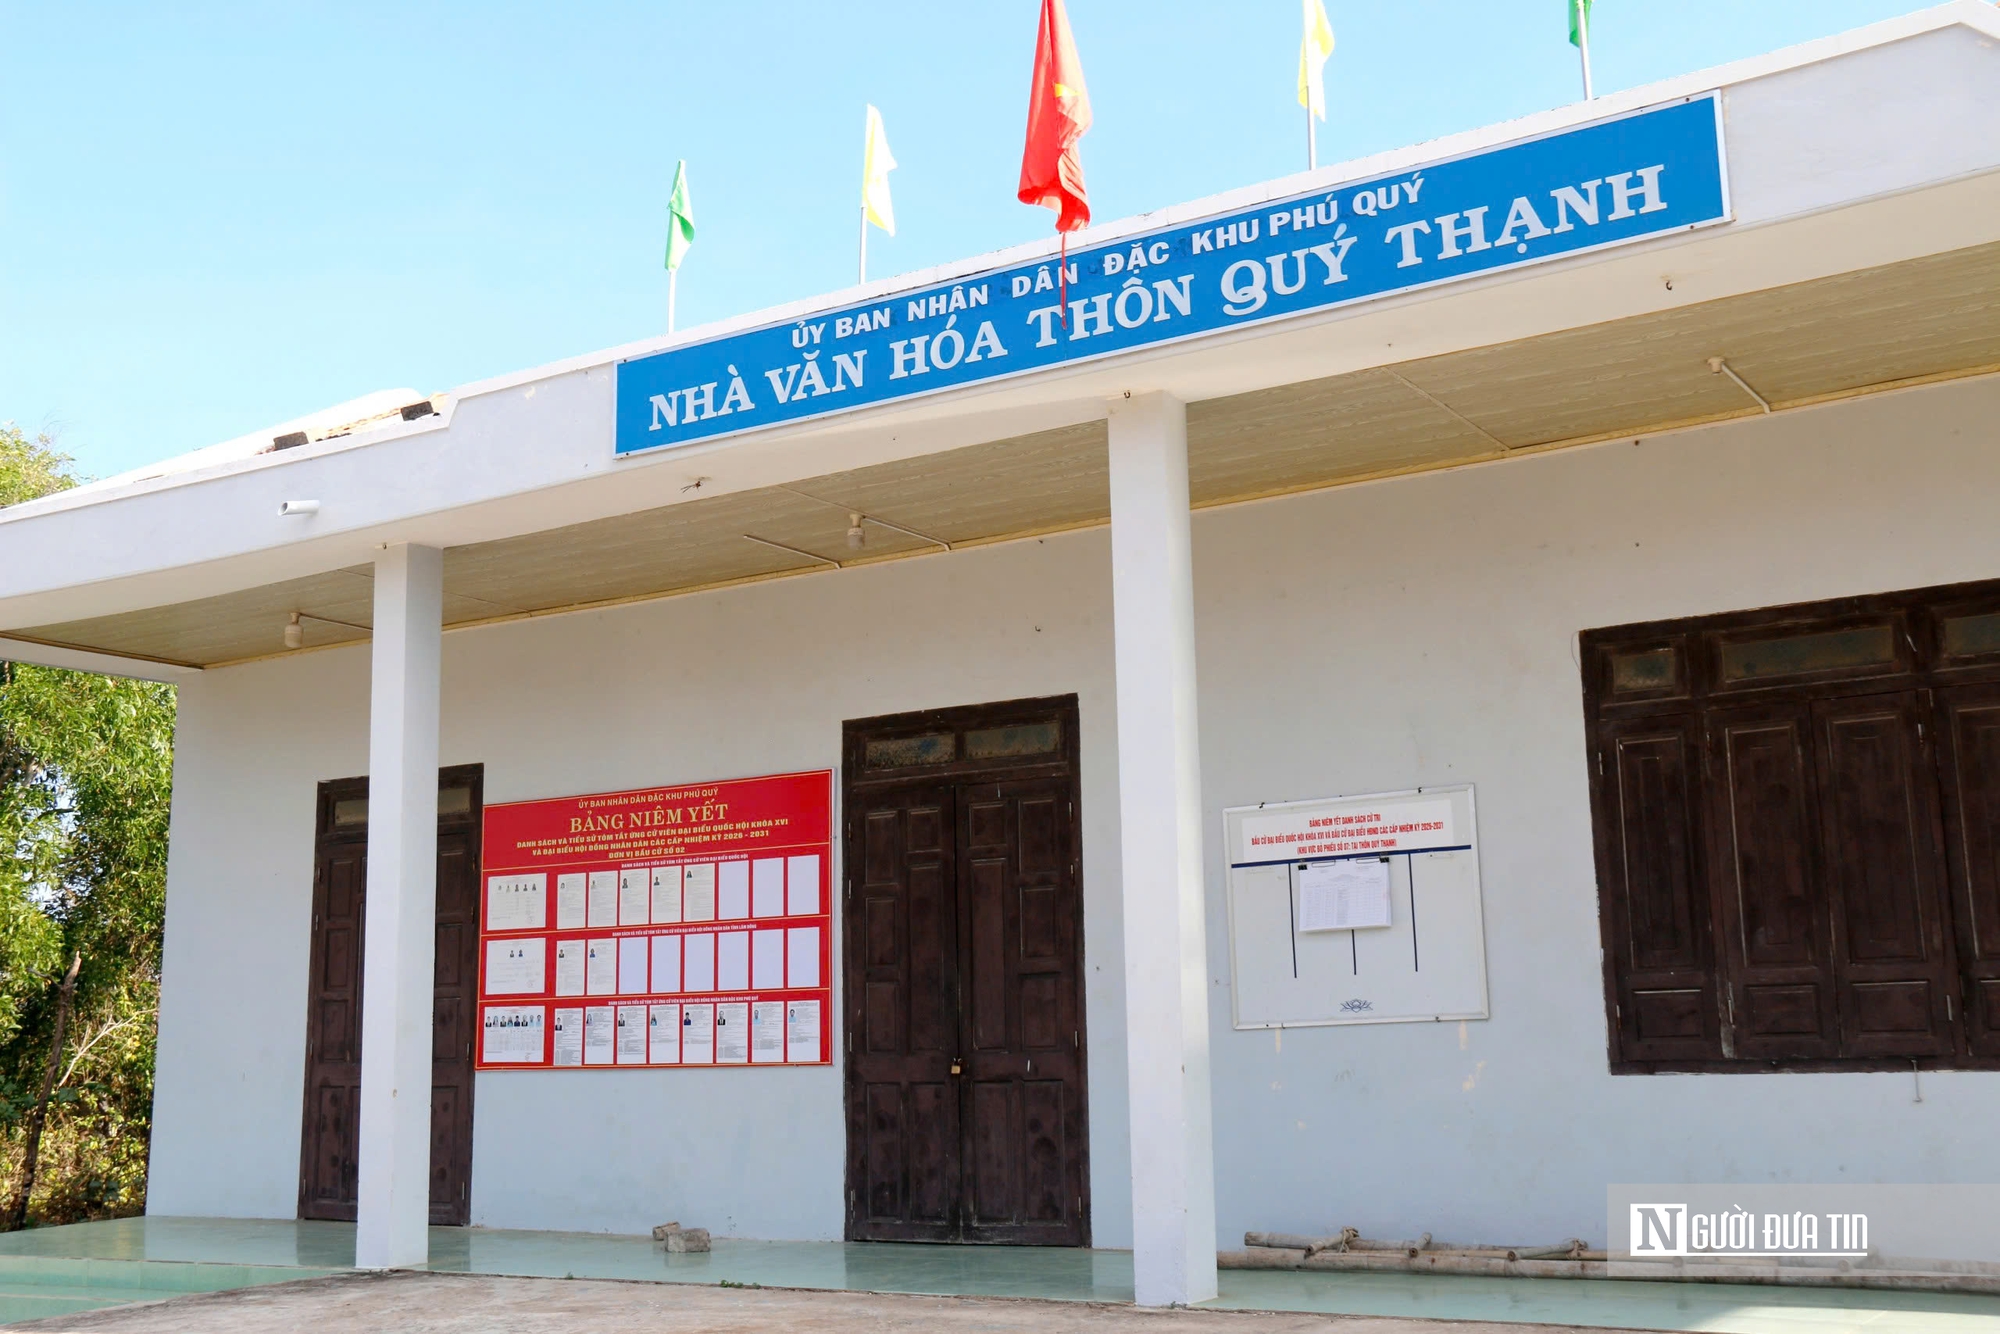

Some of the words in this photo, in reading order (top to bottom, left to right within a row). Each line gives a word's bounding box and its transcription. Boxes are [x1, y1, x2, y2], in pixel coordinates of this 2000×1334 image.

[649, 364, 755, 431] NHÀ
[765, 350, 867, 403] VĂN
[890, 314, 1007, 379] HÓA
[1026, 277, 1194, 348] THÔN
[1221, 224, 1357, 316] QUÝ
[1385, 164, 1668, 269] THẠNH
[792, 321, 826, 348] ỦY
[835, 308, 890, 339] BAN
[908, 285, 989, 321] NHÂN
[1012, 263, 1078, 298] DÂN
[1103, 243, 1169, 275] ĐẶC
[1192, 219, 1259, 254] KHU
[1270, 194, 1338, 236] PHÚ
[1353, 172, 1423, 216] QUÝ
[570, 810, 624, 833] BẢNG
[629, 805, 682, 828] NIÊM
[687, 798, 728, 822] YẾT
[578, 800, 588, 809] ỦY
[590, 800, 605, 808] BAN
[608, 796, 628, 806] NHÂN
[630, 794, 646, 804] DÂN
[648, 793, 664, 803] ĐẶC
[666, 792, 682, 801] KHU
[684, 788, 700, 799] PHÚ
[702, 786, 718, 797] QUÝ
